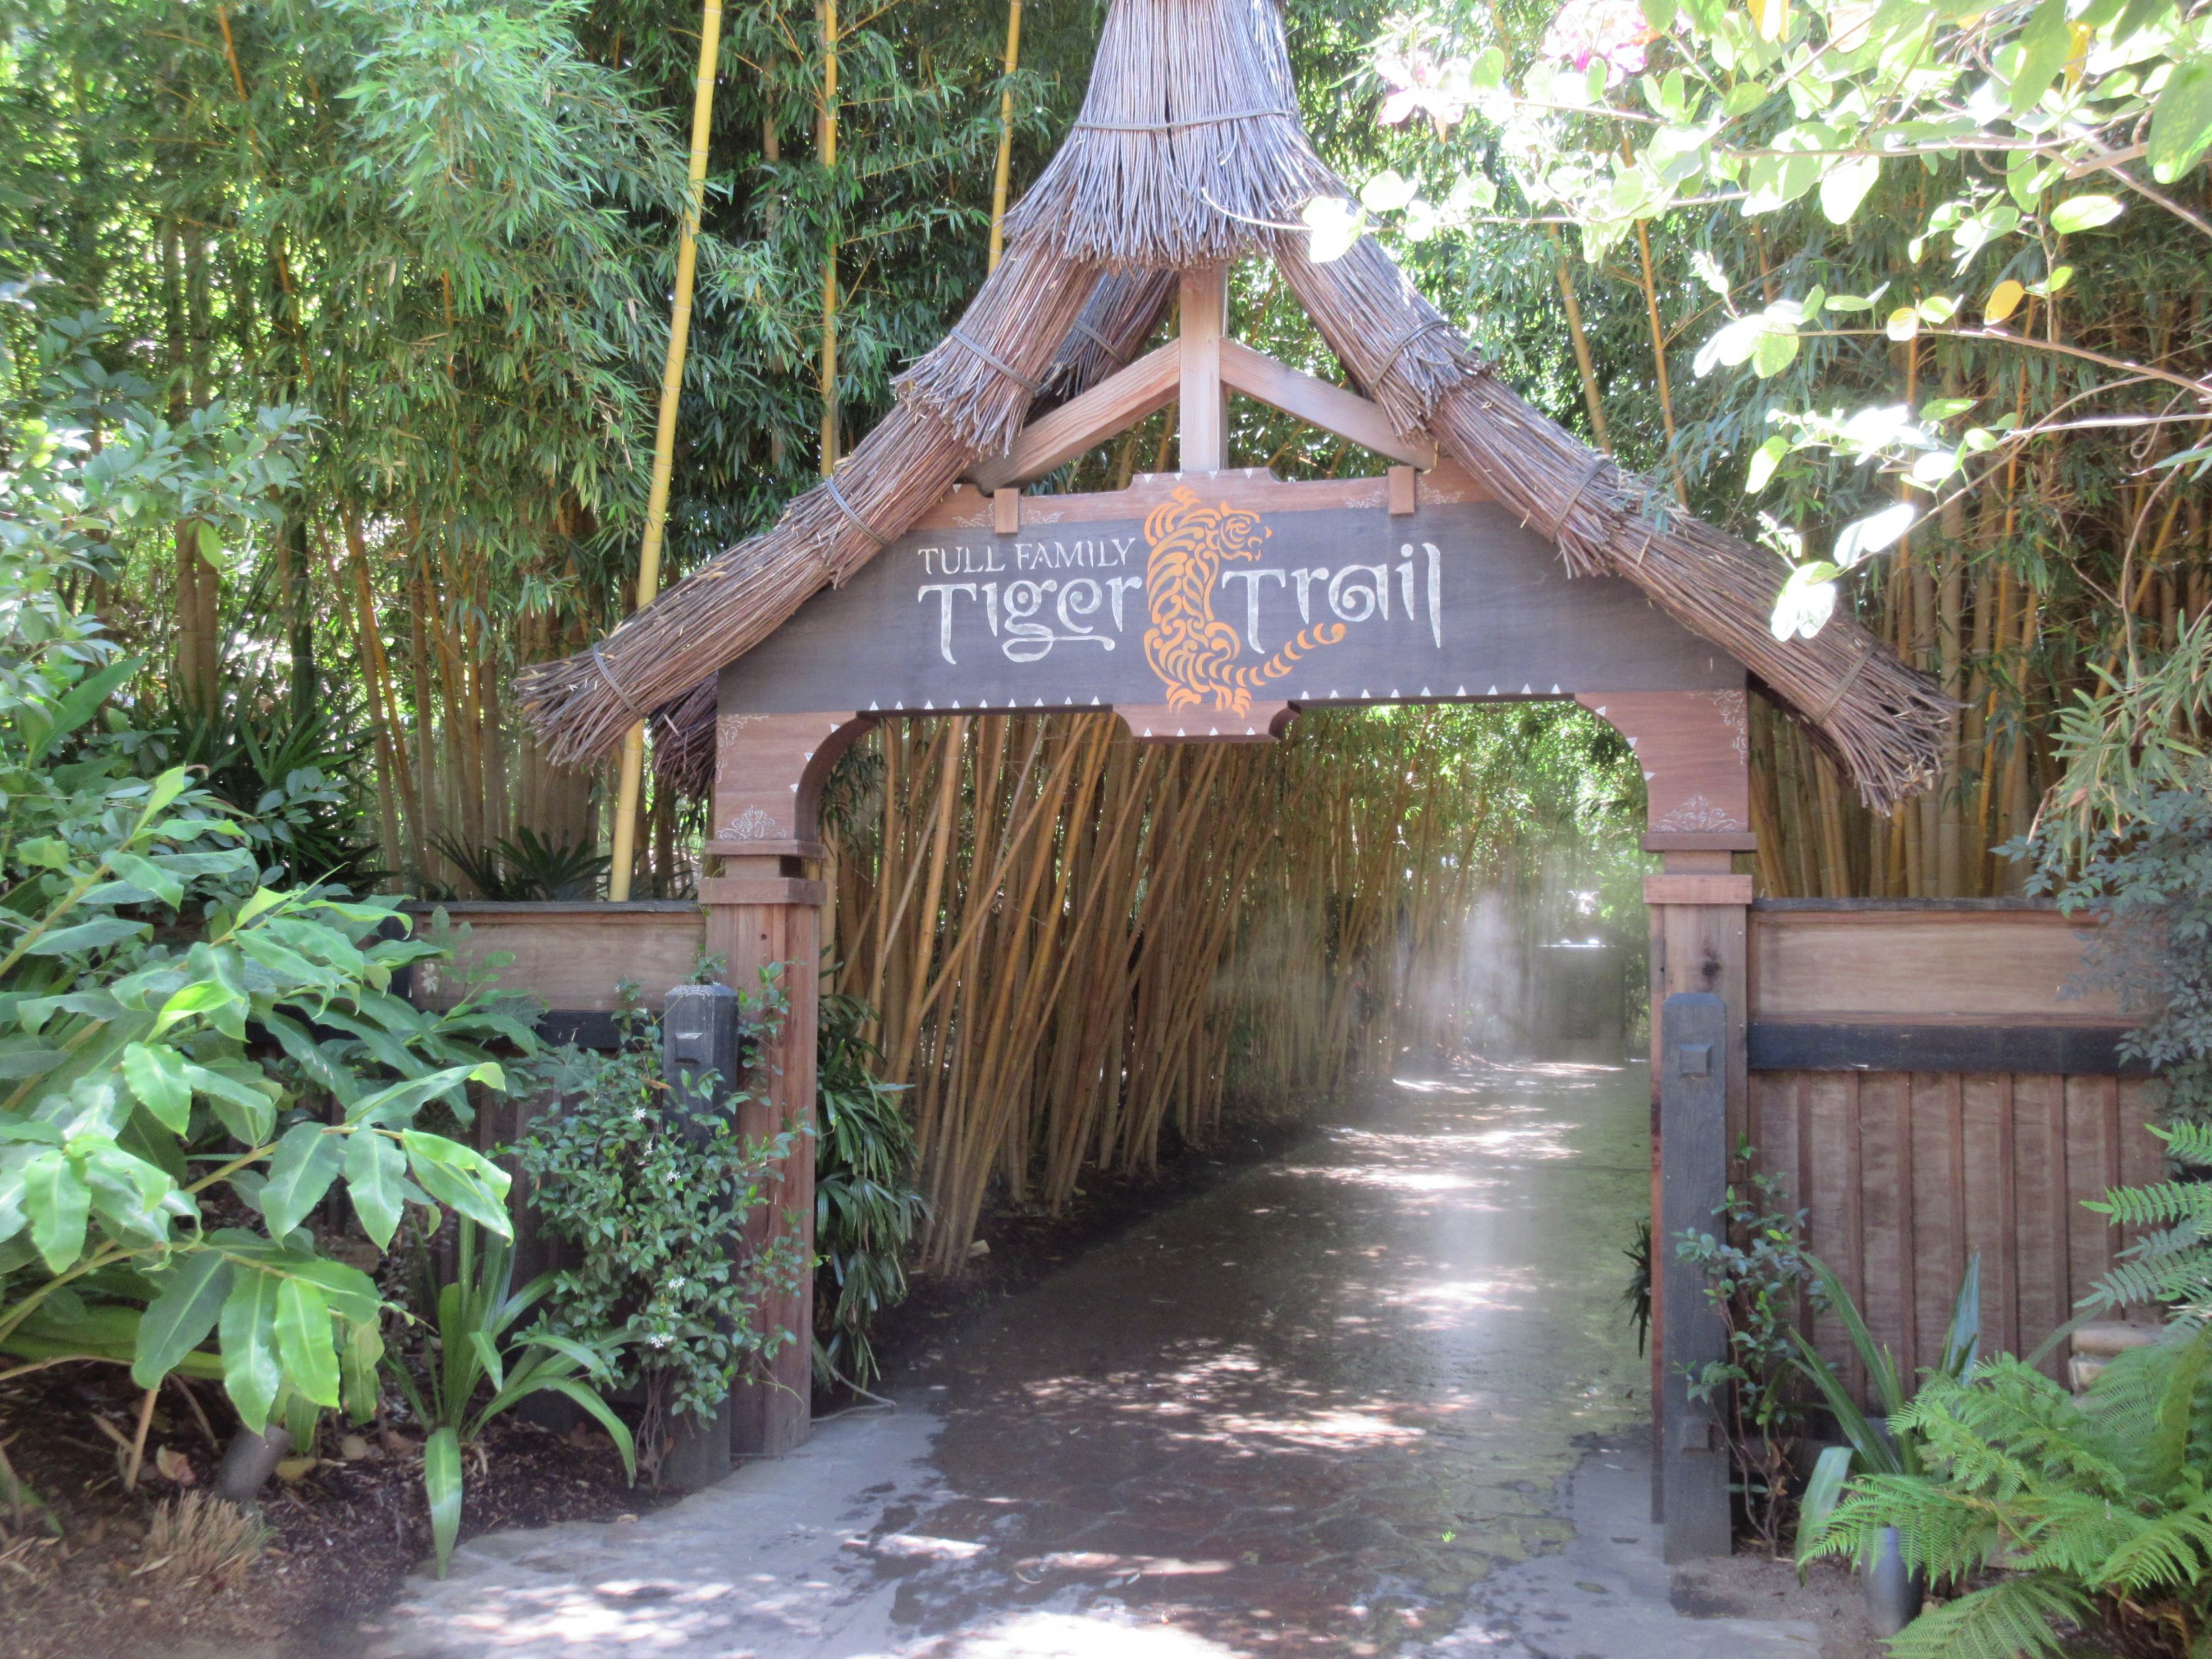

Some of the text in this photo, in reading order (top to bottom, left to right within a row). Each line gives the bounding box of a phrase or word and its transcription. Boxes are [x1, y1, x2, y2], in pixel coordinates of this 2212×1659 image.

[918, 538, 1136, 575] TULL FAMILY
[919, 543, 1441, 664] Tiger Trail
